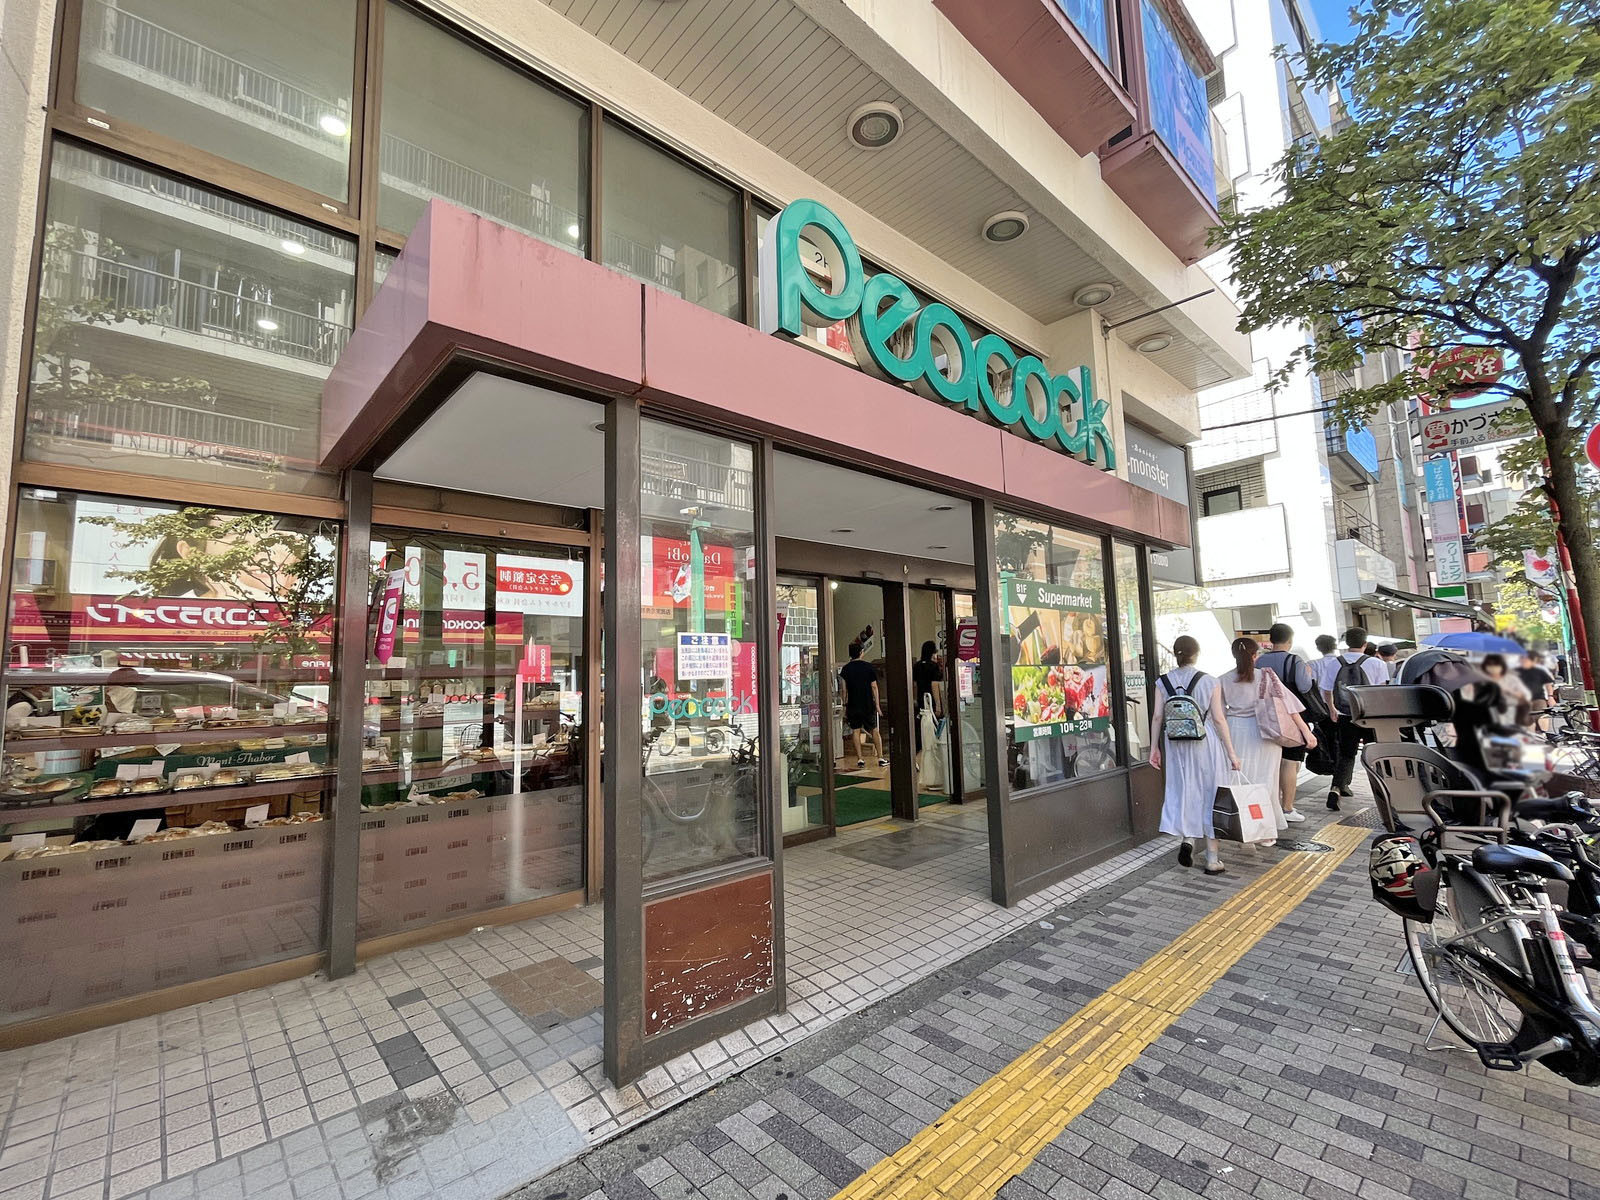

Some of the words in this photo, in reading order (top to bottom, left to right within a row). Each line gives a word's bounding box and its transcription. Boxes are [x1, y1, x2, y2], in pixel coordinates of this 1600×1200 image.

[776, 198, 1116, 471] Peacock
[1450, 434, 1486, 447] 手前入る
[1447, 541, 1461, 581] クリーニング
[1016, 583, 1027, 593] B1F
[1038, 588, 1093, 608] Supermarket
